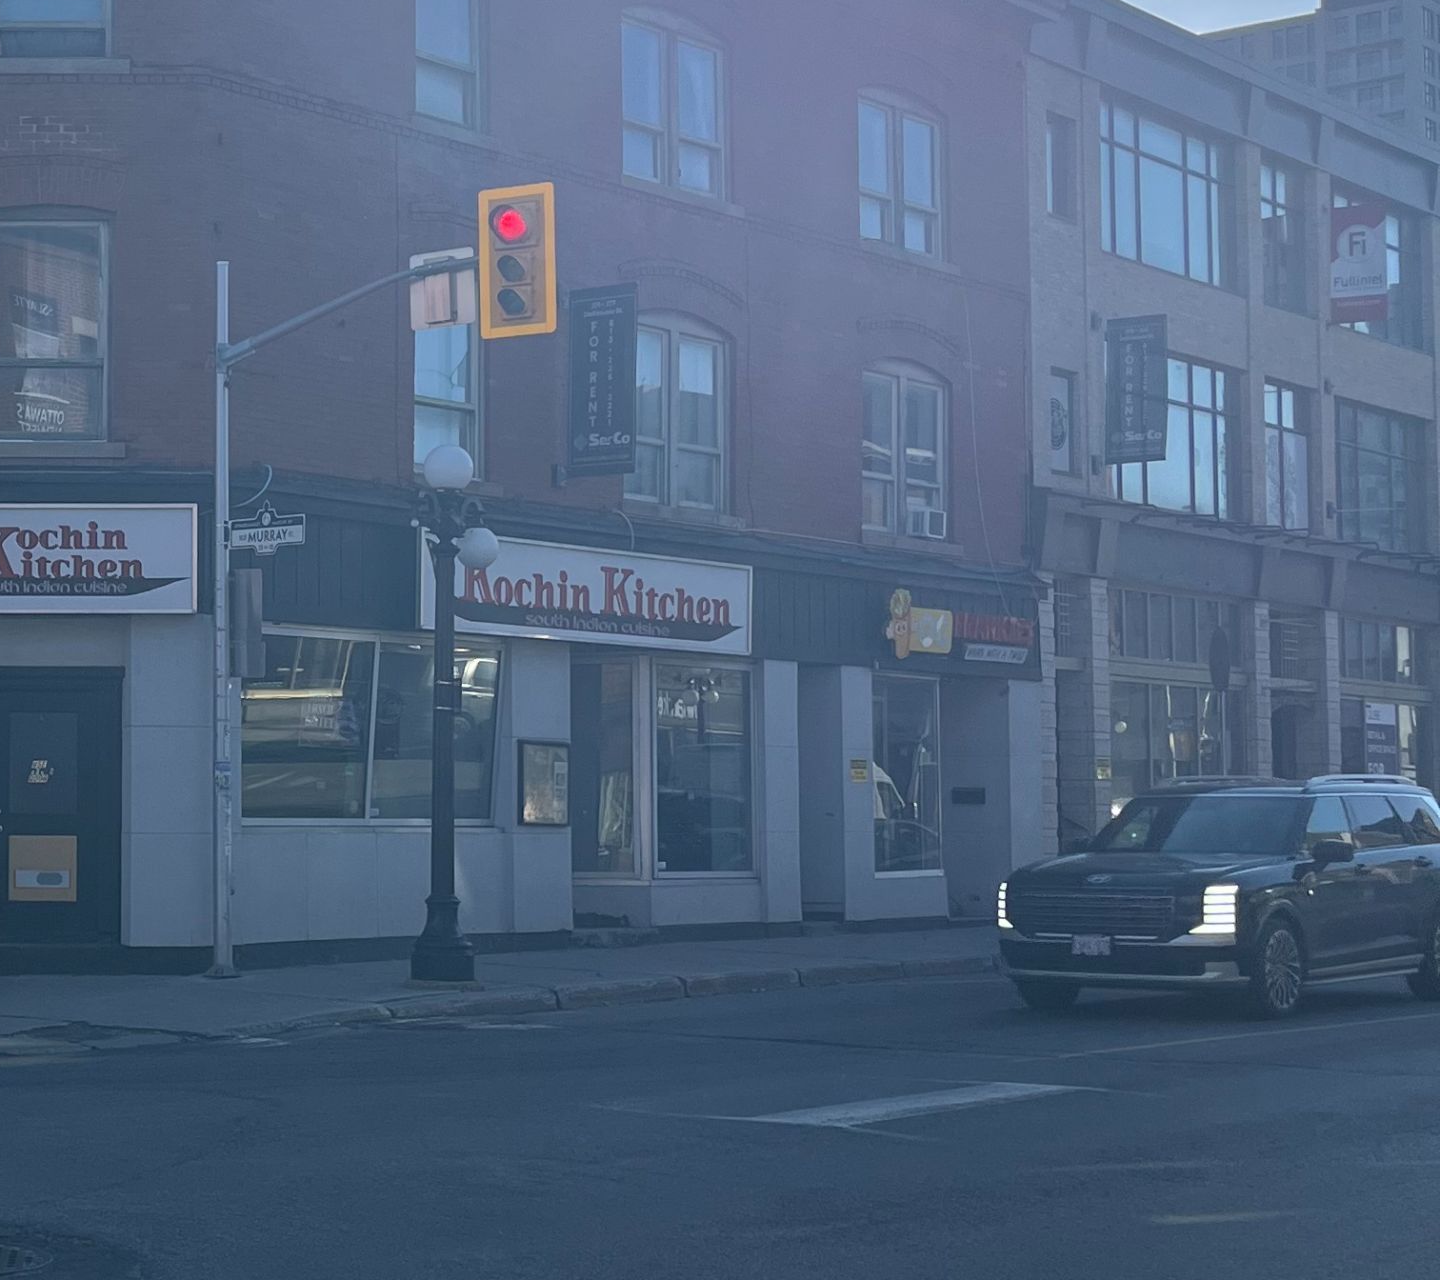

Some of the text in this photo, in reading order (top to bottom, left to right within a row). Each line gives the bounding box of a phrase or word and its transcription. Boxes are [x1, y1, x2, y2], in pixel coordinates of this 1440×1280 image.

[588, 321, 599, 428] FOR RENT
[247, 528, 289, 542] MURRAY
[73, 580, 128, 593] cuisine
[461, 566, 732, 627] Kochin Kitchen
[525, 613, 570, 628] south
[621, 621, 671, 636] cuisine
